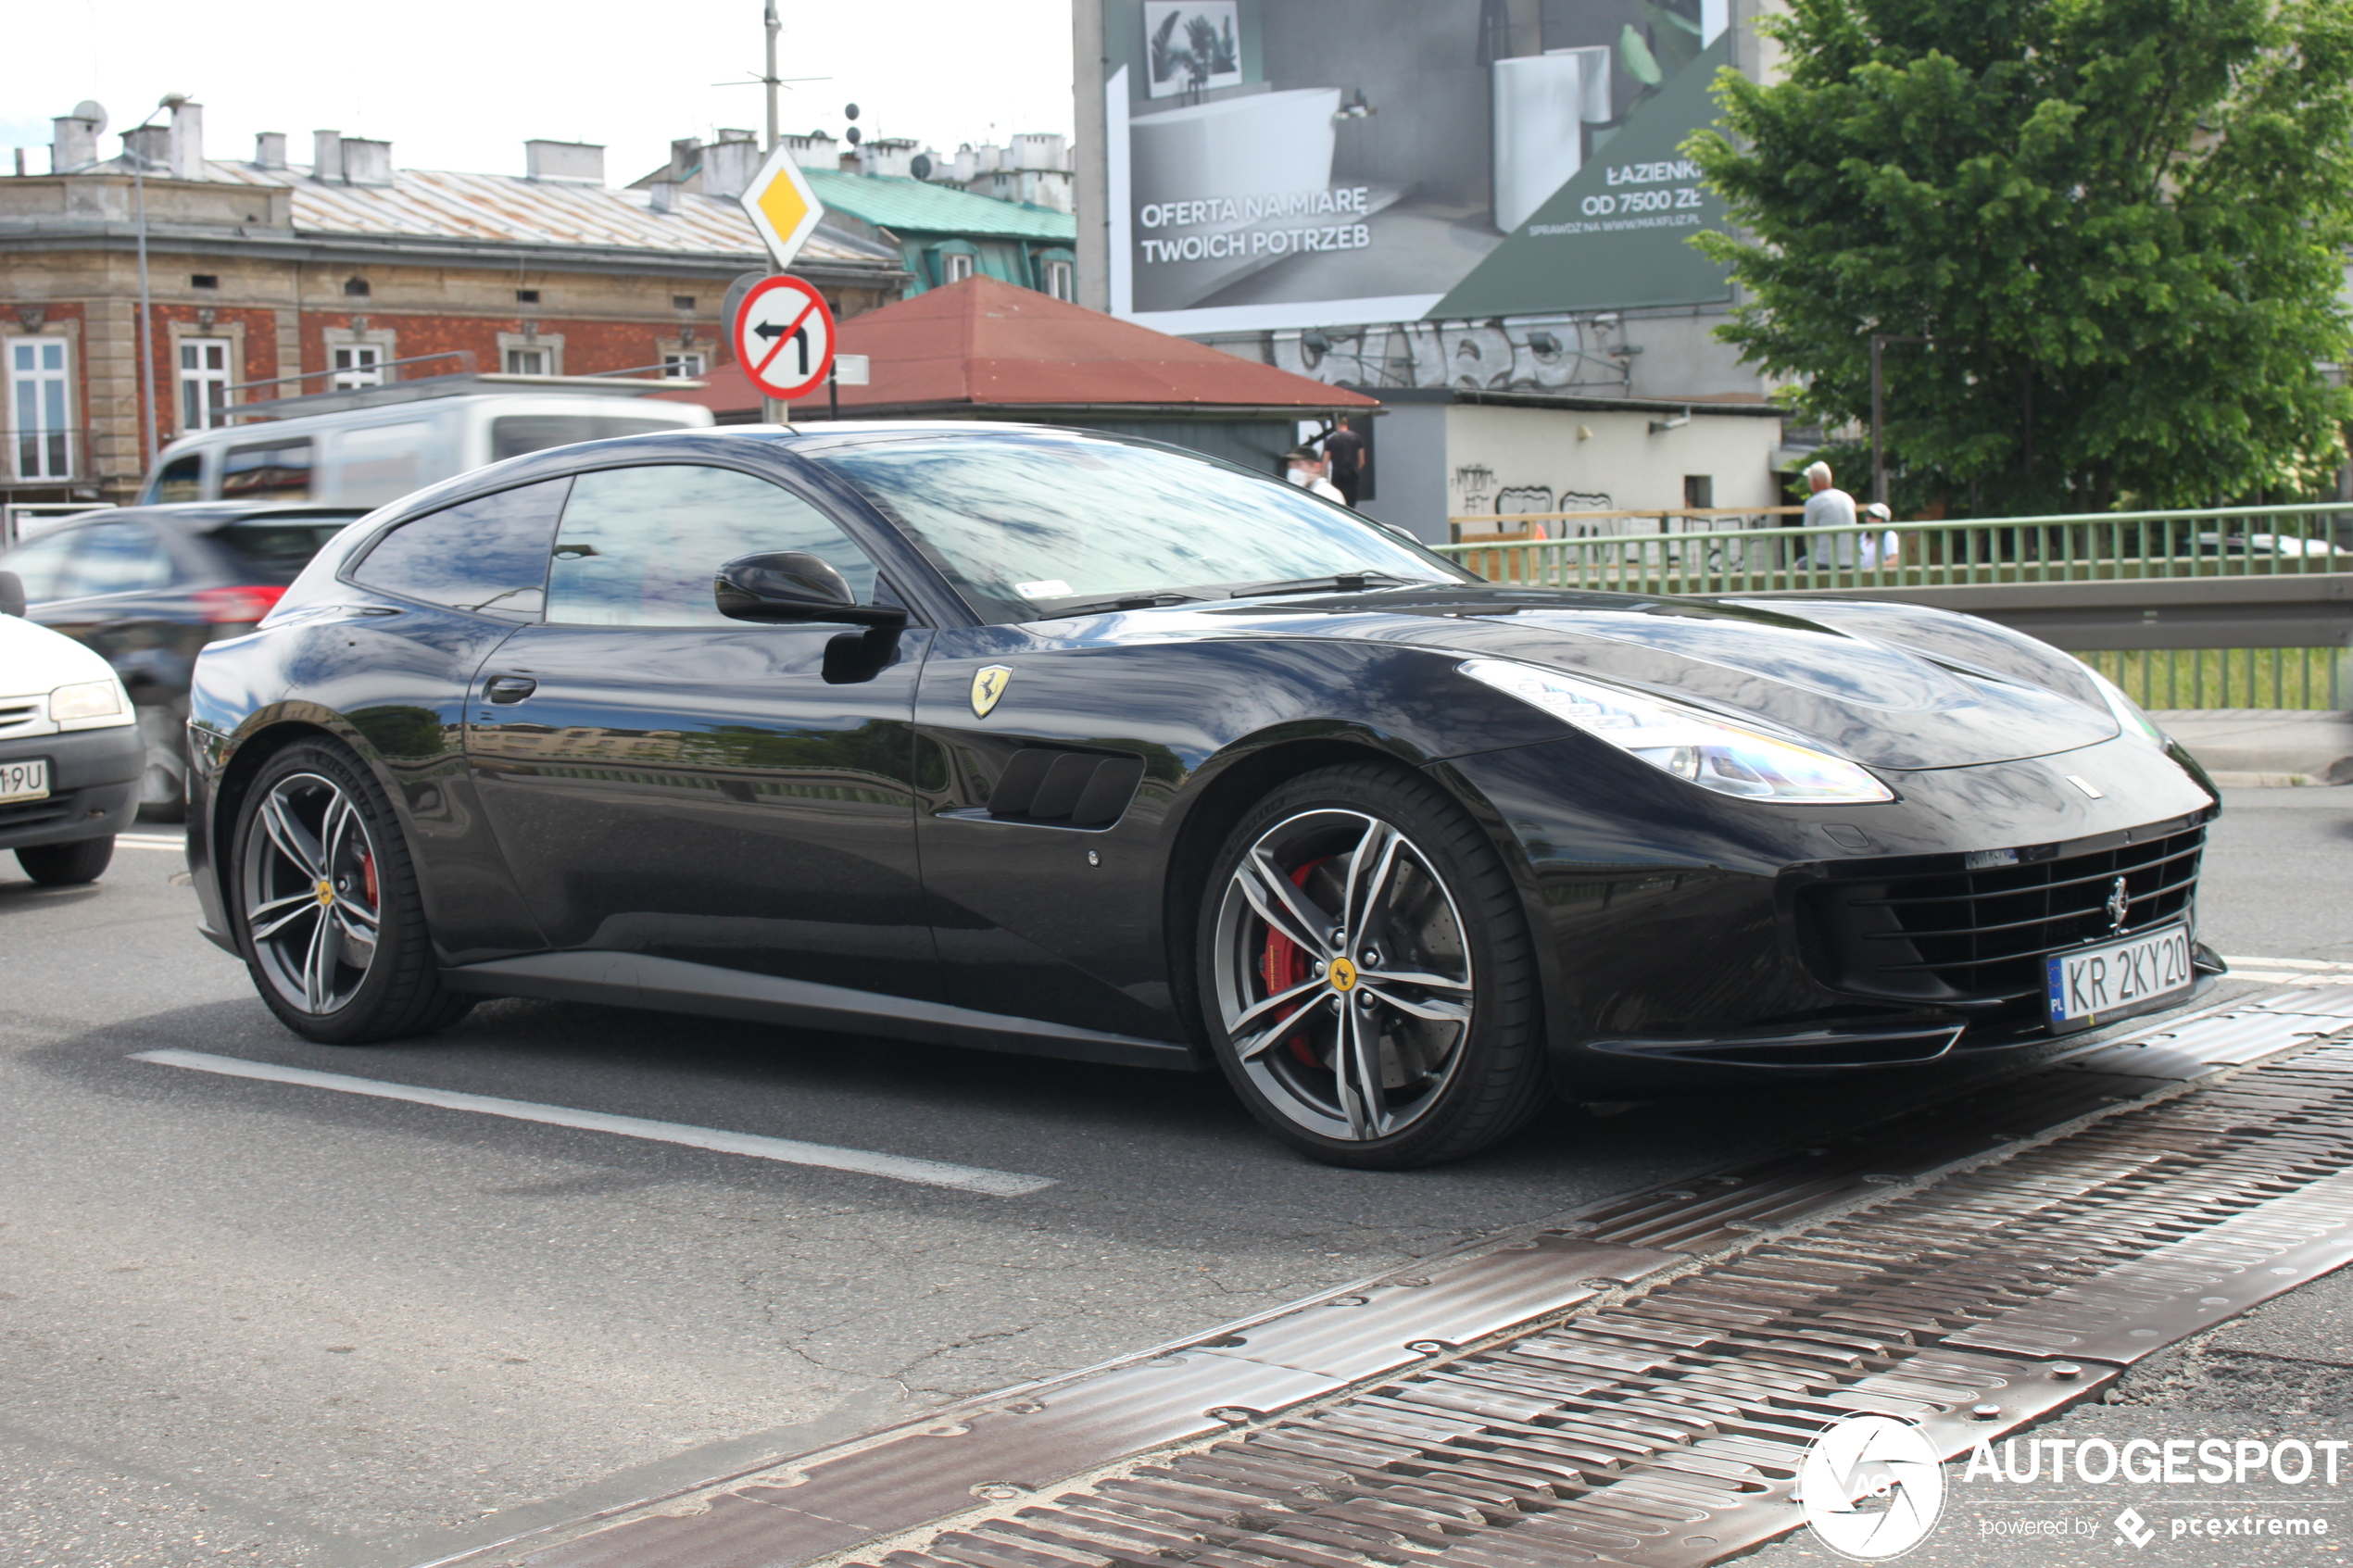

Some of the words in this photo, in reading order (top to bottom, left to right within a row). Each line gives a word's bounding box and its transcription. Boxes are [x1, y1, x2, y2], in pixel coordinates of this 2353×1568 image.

[1140, 198, 1238, 229] OFERTA
[1245, 194, 1282, 219] NA
[1290, 187, 1369, 215] MIARĘ
[1581, 194, 1616, 216] OD
[1619, 191, 1671, 213] 7500
[1675, 188, 1703, 208] ZŁ
[1141, 232, 1246, 263] TWOICH
[1252, 223, 1370, 255] POTRZEB
[1583, 221, 1601, 232] NA
[2069, 955, 2108, 1012] KR
[2117, 934, 2187, 1000] 2KY20
[2051, 997, 2064, 1012] PL
